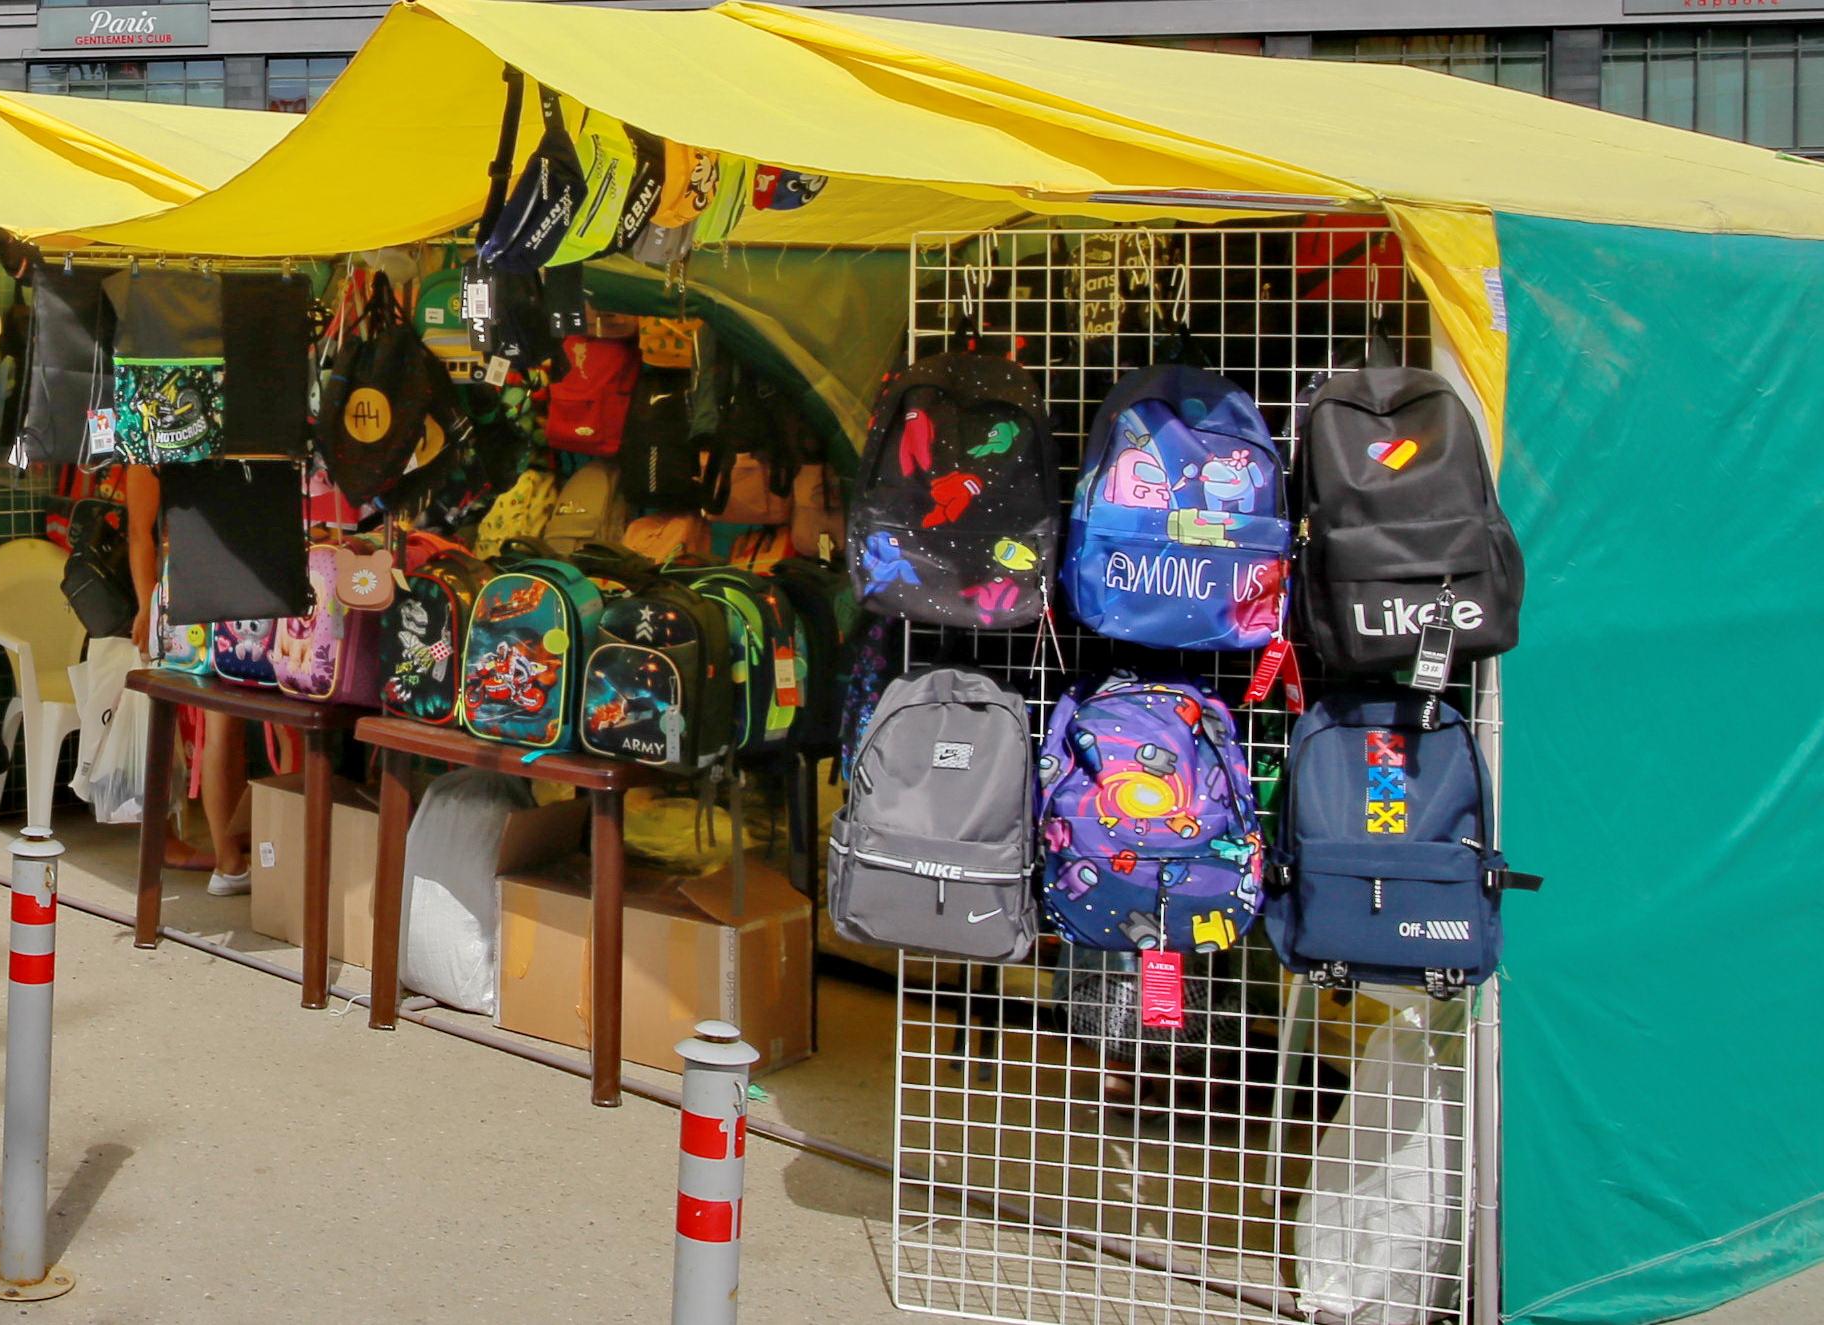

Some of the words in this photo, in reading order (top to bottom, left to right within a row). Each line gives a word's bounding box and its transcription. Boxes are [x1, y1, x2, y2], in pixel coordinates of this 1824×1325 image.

[89, 10, 158, 35] Paris
[146, 33, 173, 44] CLUB
[352, 401, 380, 429] A4
[155, 415, 208, 443] MOTOCROSS
[1106, 551, 1217, 600] AMONG
[1232, 562, 1268, 603] US
[621, 737, 665, 756] ARMY
[914, 860, 962, 880] NIKE
[1398, 921, 1426, 938] Off-
